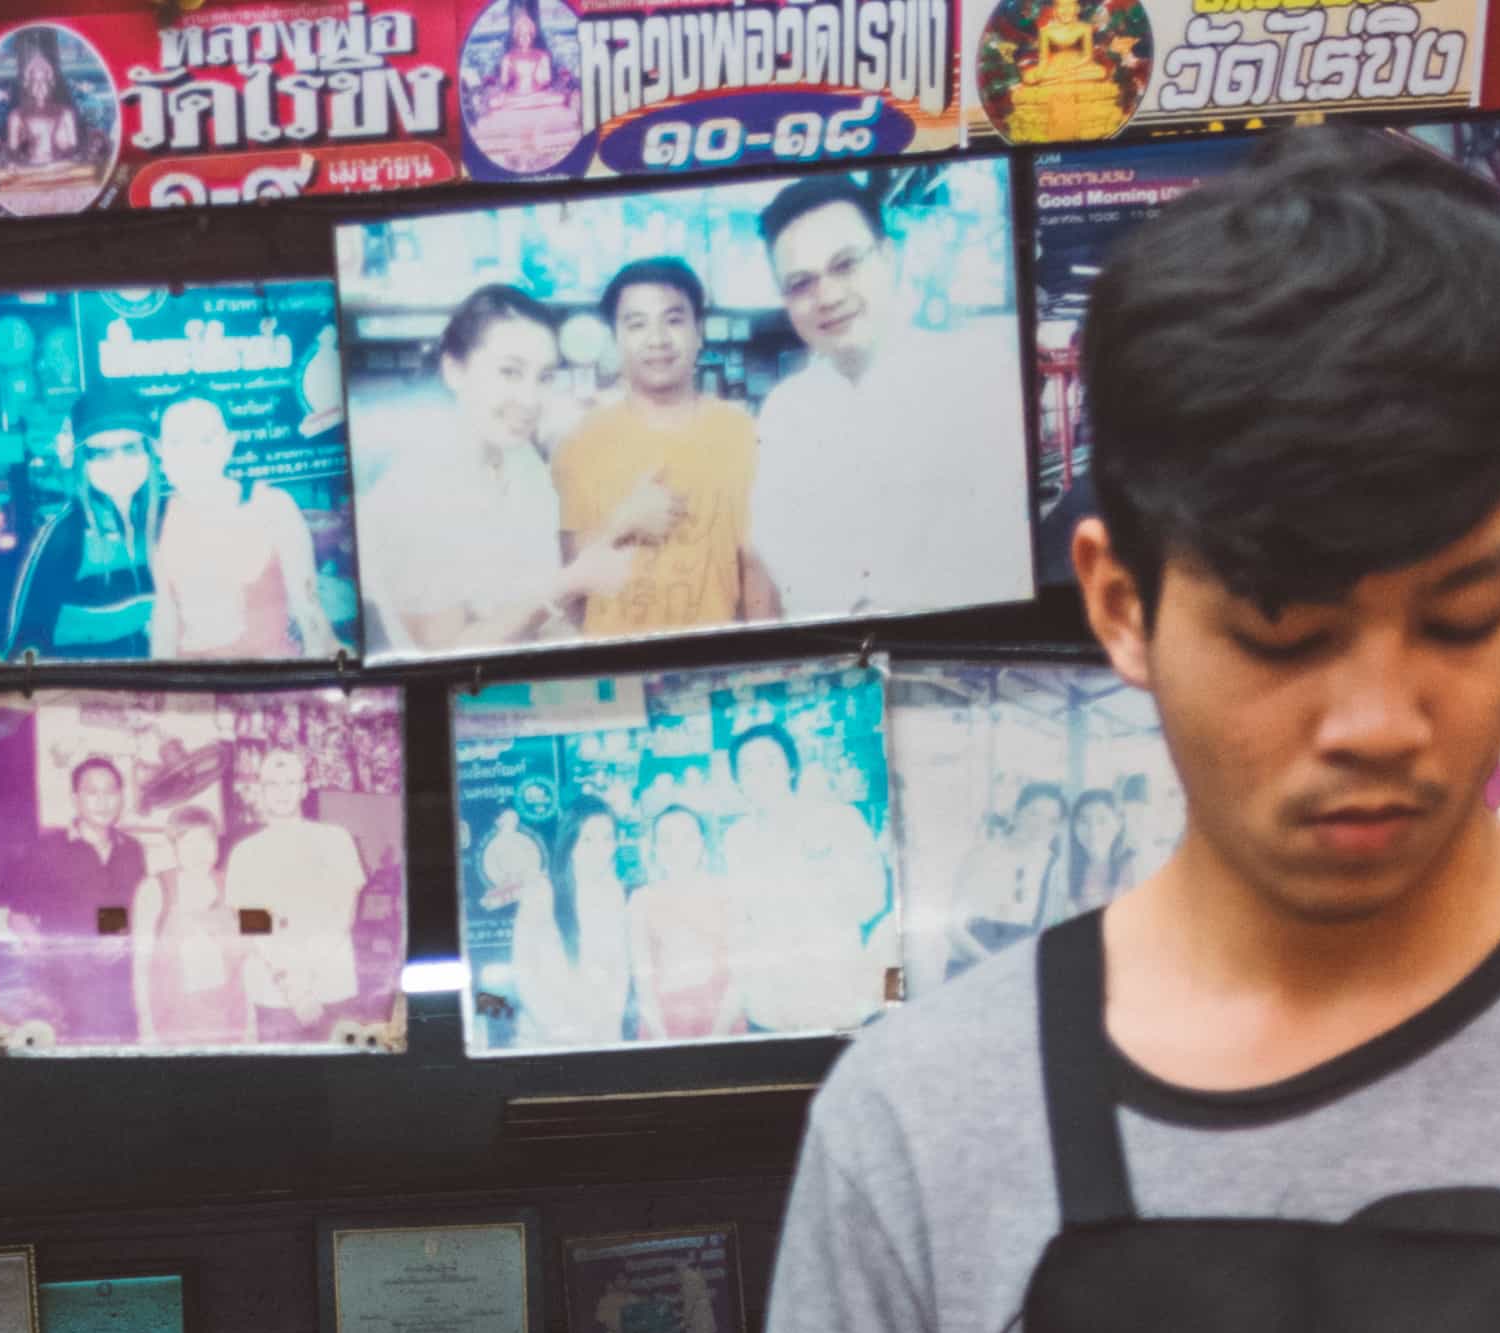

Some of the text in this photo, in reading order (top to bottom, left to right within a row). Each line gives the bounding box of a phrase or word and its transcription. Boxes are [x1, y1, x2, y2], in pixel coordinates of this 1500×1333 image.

[1161, 5, 1465, 111] วัดไร่ขิง
[1037, 190, 1083, 209] Good
[1086, 186, 1159, 207] Morning
